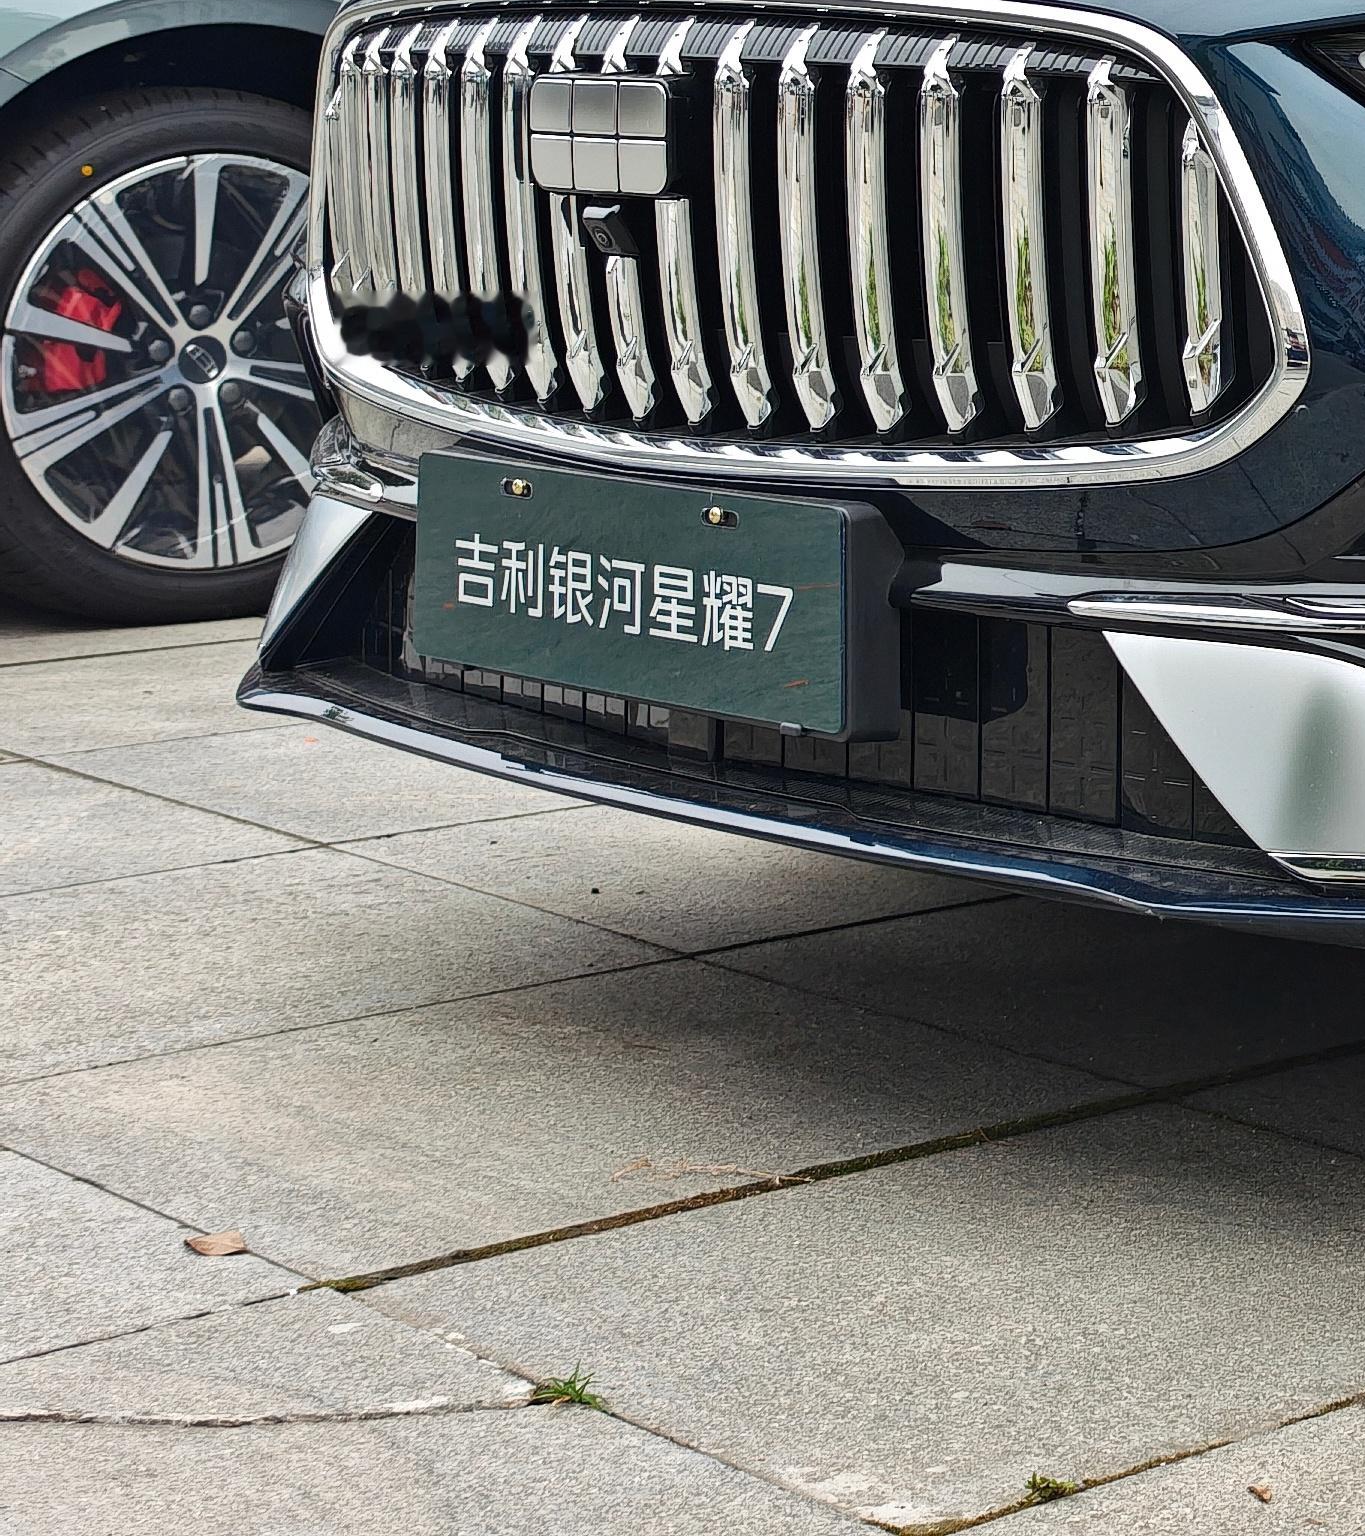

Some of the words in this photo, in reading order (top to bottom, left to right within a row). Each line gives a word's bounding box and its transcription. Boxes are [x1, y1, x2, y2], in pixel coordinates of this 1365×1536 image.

[454, 531, 795, 654] 吉利银河星耀7
